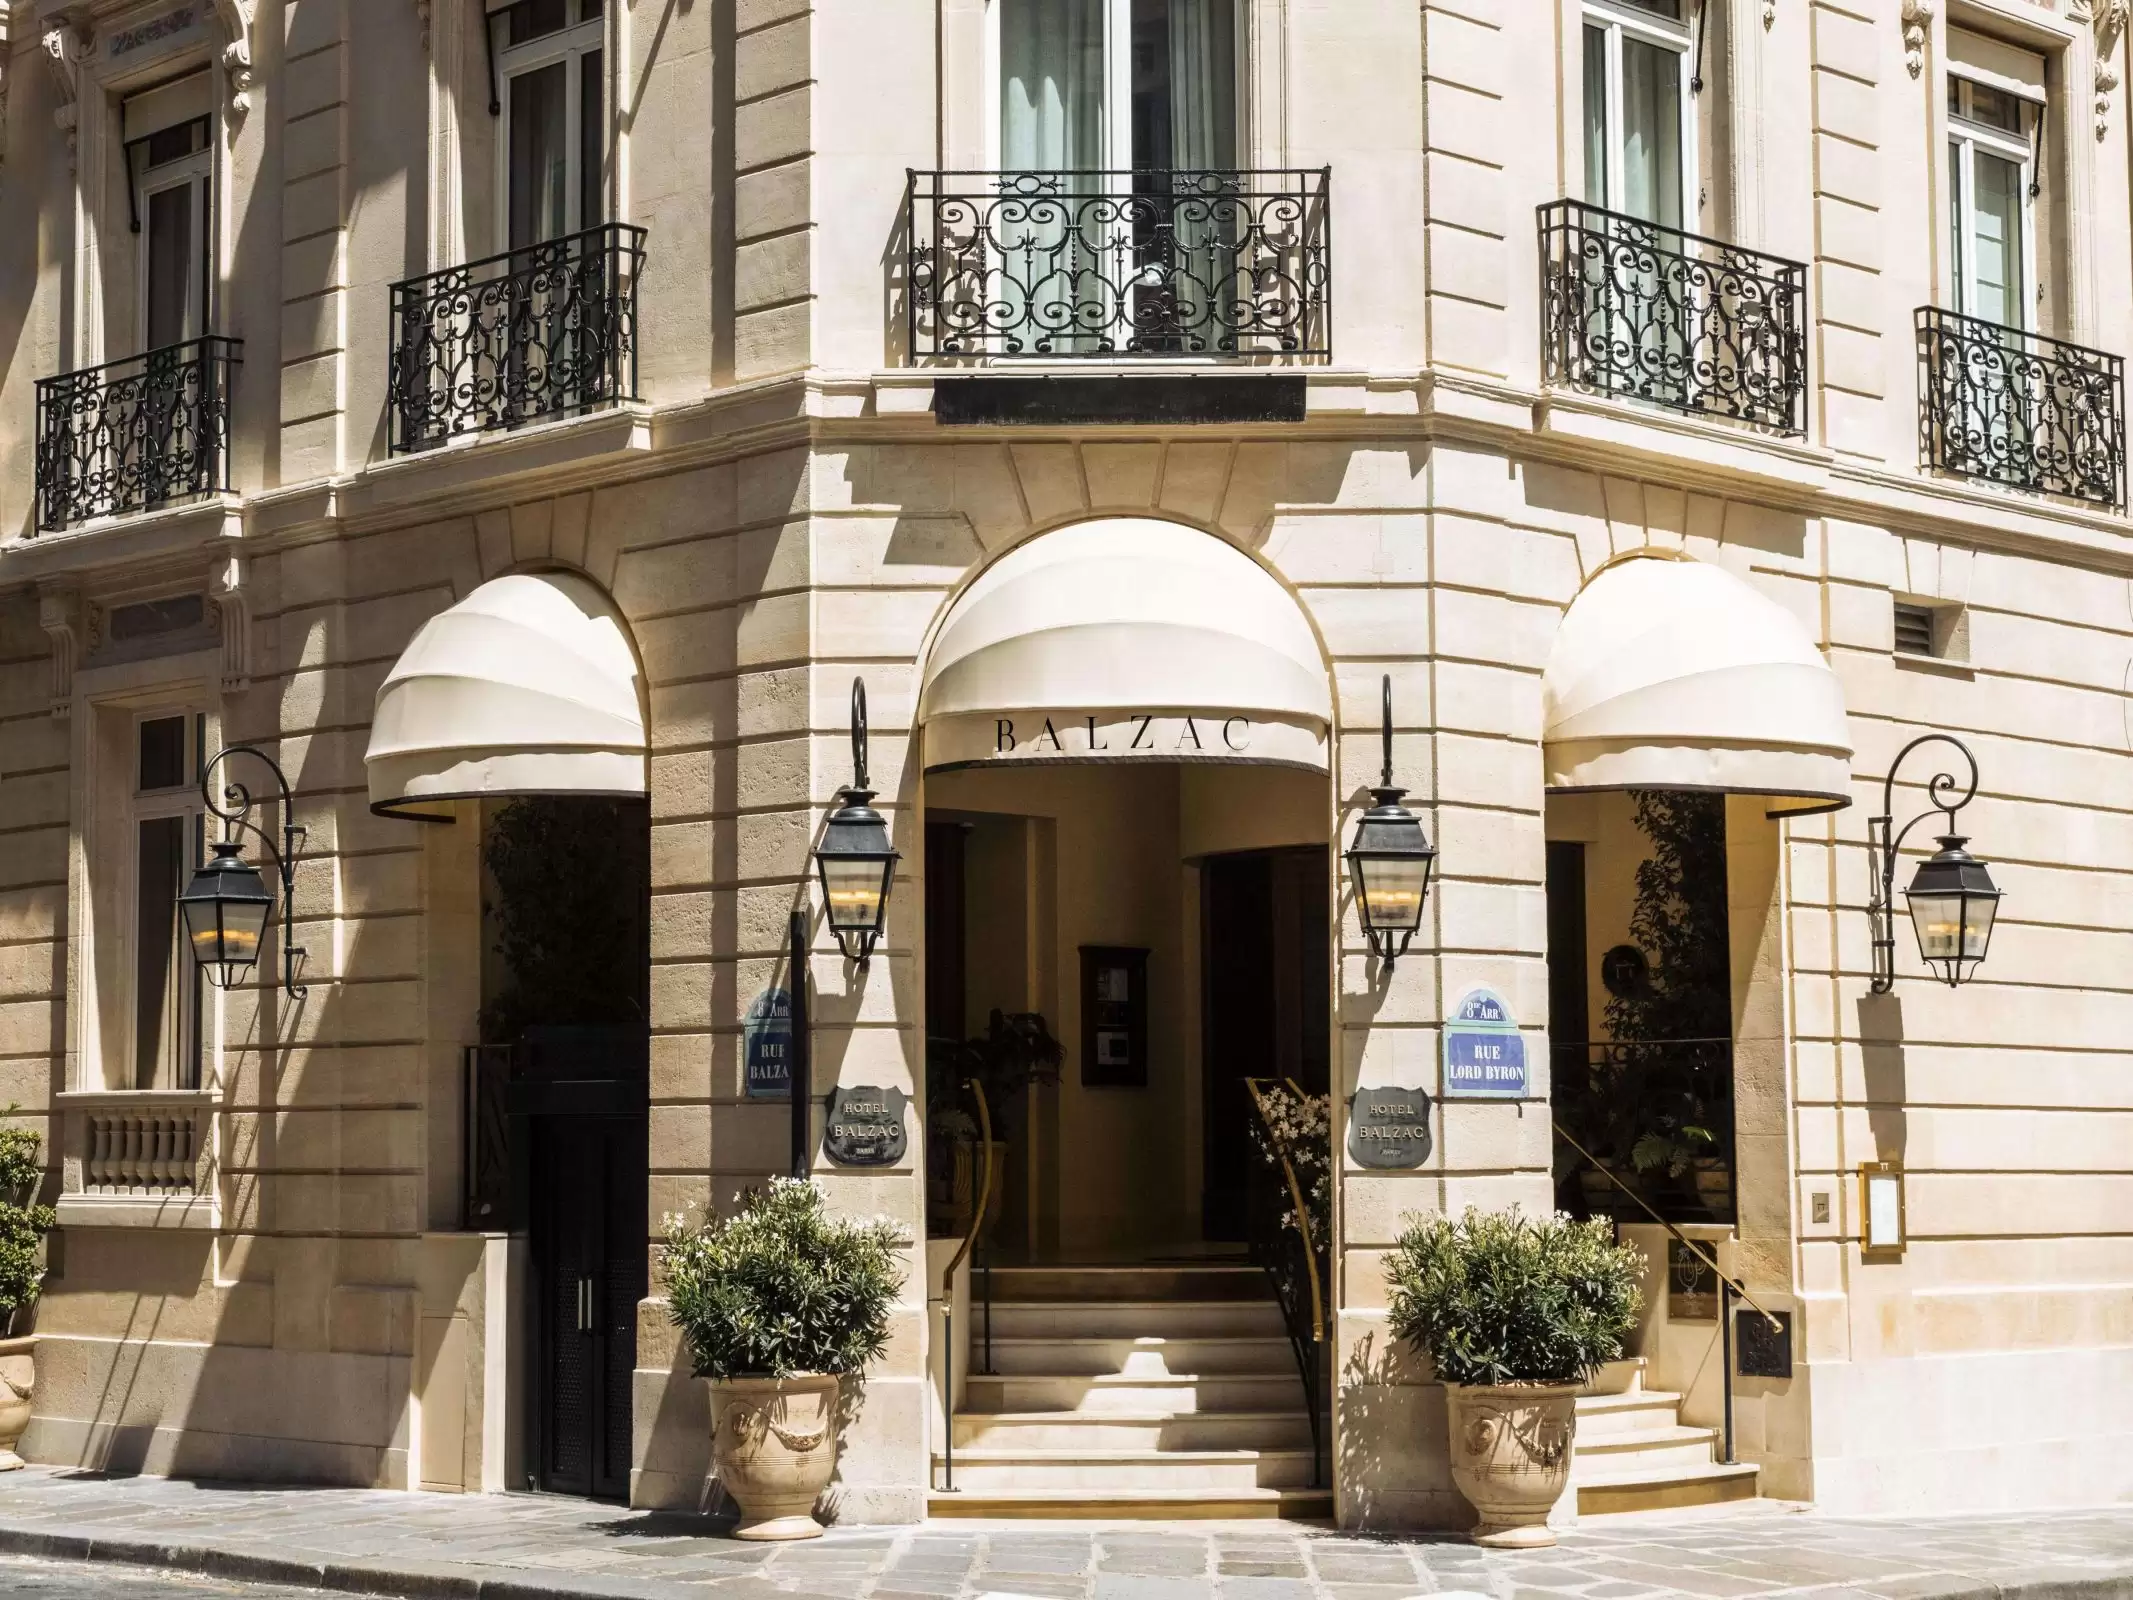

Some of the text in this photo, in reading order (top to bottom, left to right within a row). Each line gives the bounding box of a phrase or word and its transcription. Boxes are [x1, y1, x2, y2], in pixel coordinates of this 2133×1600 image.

[994, 714, 1250, 752] BALZAC
[1474, 1045, 1501, 1060] RUE
[1449, 1065, 1524, 1080] LORD BYRON
[845, 1103, 889, 1113] HOTEL
[1369, 1104, 1414, 1114] HOTEL
[834, 1125, 899, 1137] BALZAC
[1359, 1126, 1424, 1138] BALZAC
